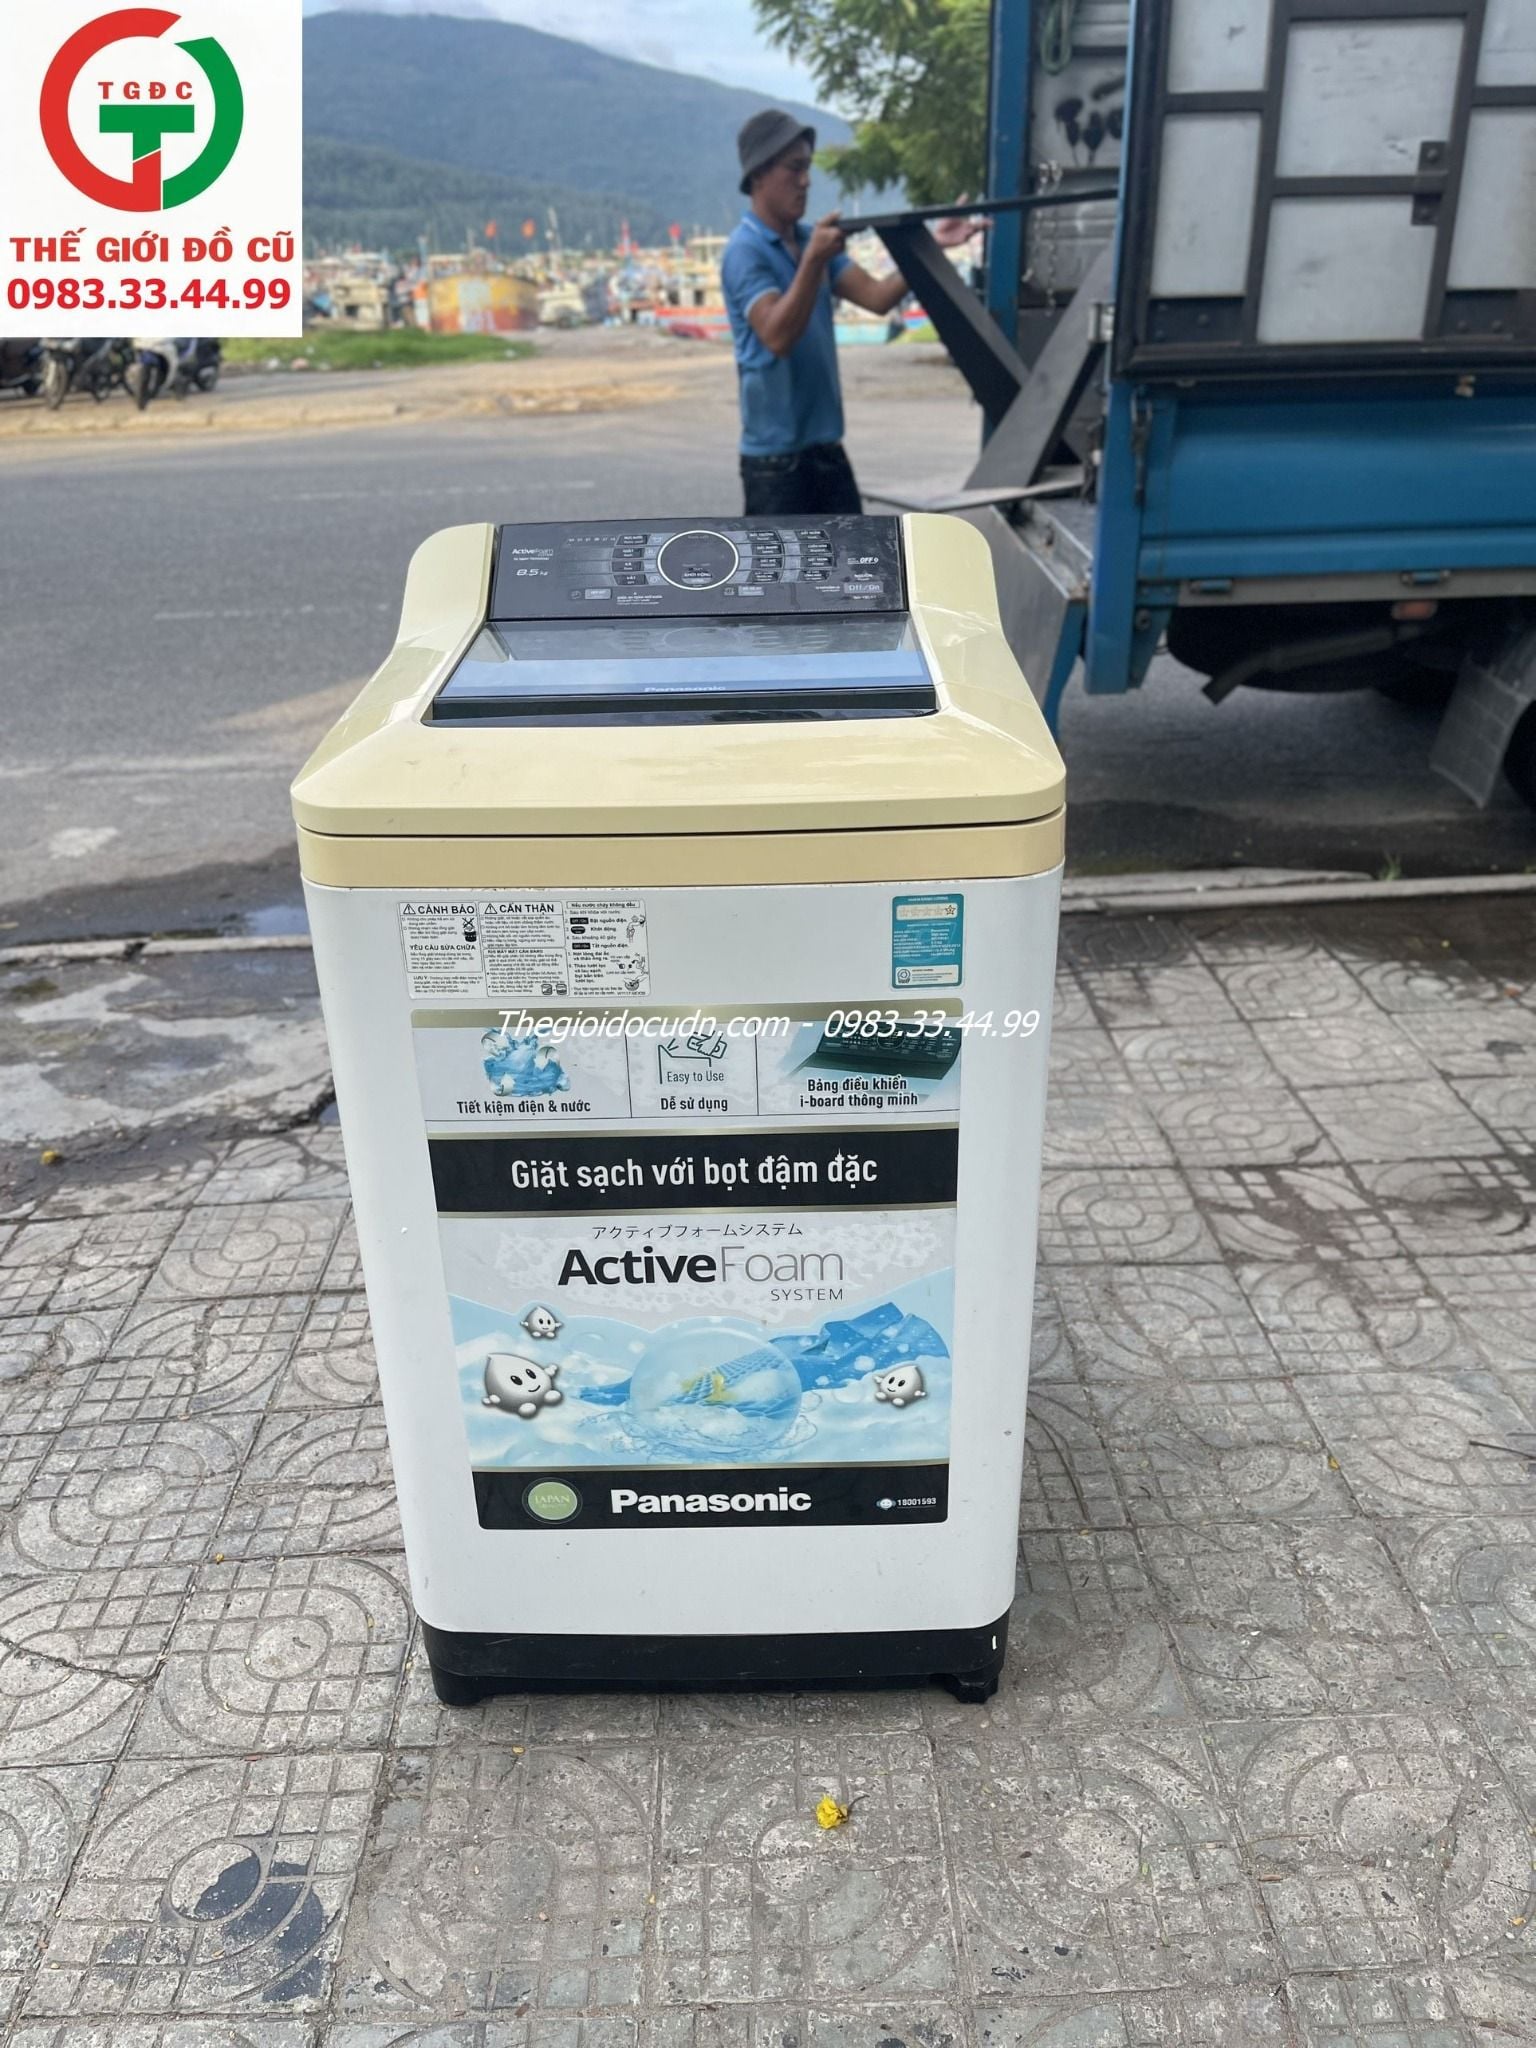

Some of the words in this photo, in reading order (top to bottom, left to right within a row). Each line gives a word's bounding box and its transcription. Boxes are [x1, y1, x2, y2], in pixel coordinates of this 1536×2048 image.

[516, 568, 540, 577] 8.5
[417, 904, 448, 915] CẢNH
[525, 903, 554, 915] THẬN
[667, 1071, 690, 1085] Easy
[693, 1072, 703, 1082] to
[706, 1071, 724, 1082] Use
[807, 1078, 839, 1093] Bảng
[843, 1076, 869, 1091] điều
[873, 1075, 907, 1090] khiển
[457, 1100, 481, 1114] Tiết
[485, 1100, 514, 1116] kiệm
[518, 1100, 545, 1115] điện
[548, 1101, 557, 1112] &
[561, 1099, 591, 1112] nước
[661, 1096, 676, 1110] Dễ
[680, 1097, 695, 1110] sử
[698, 1098, 728, 1112] dụng
[800, 1095, 845, 1107] i-board
[849, 1094, 883, 1108] thông
[888, 1093, 918, 1106] minh
[511, 1160, 569, 1195] Giặt
[577, 1159, 643, 1194] sạch
[652, 1157, 694, 1186] với
[704, 1157, 749, 1191] bọt
[758, 1154, 818, 1190] đậm
[827, 1153, 878, 1189] đặc
[591, 1222, 804, 1240] アクティブフォームシステム
[557, 1244, 845, 1287] ActiveFoam
[770, 1288, 843, 1301] SYSTEM
[610, 1486, 812, 1514] Panasonic
[897, 1497, 937, 1506] 18001593
